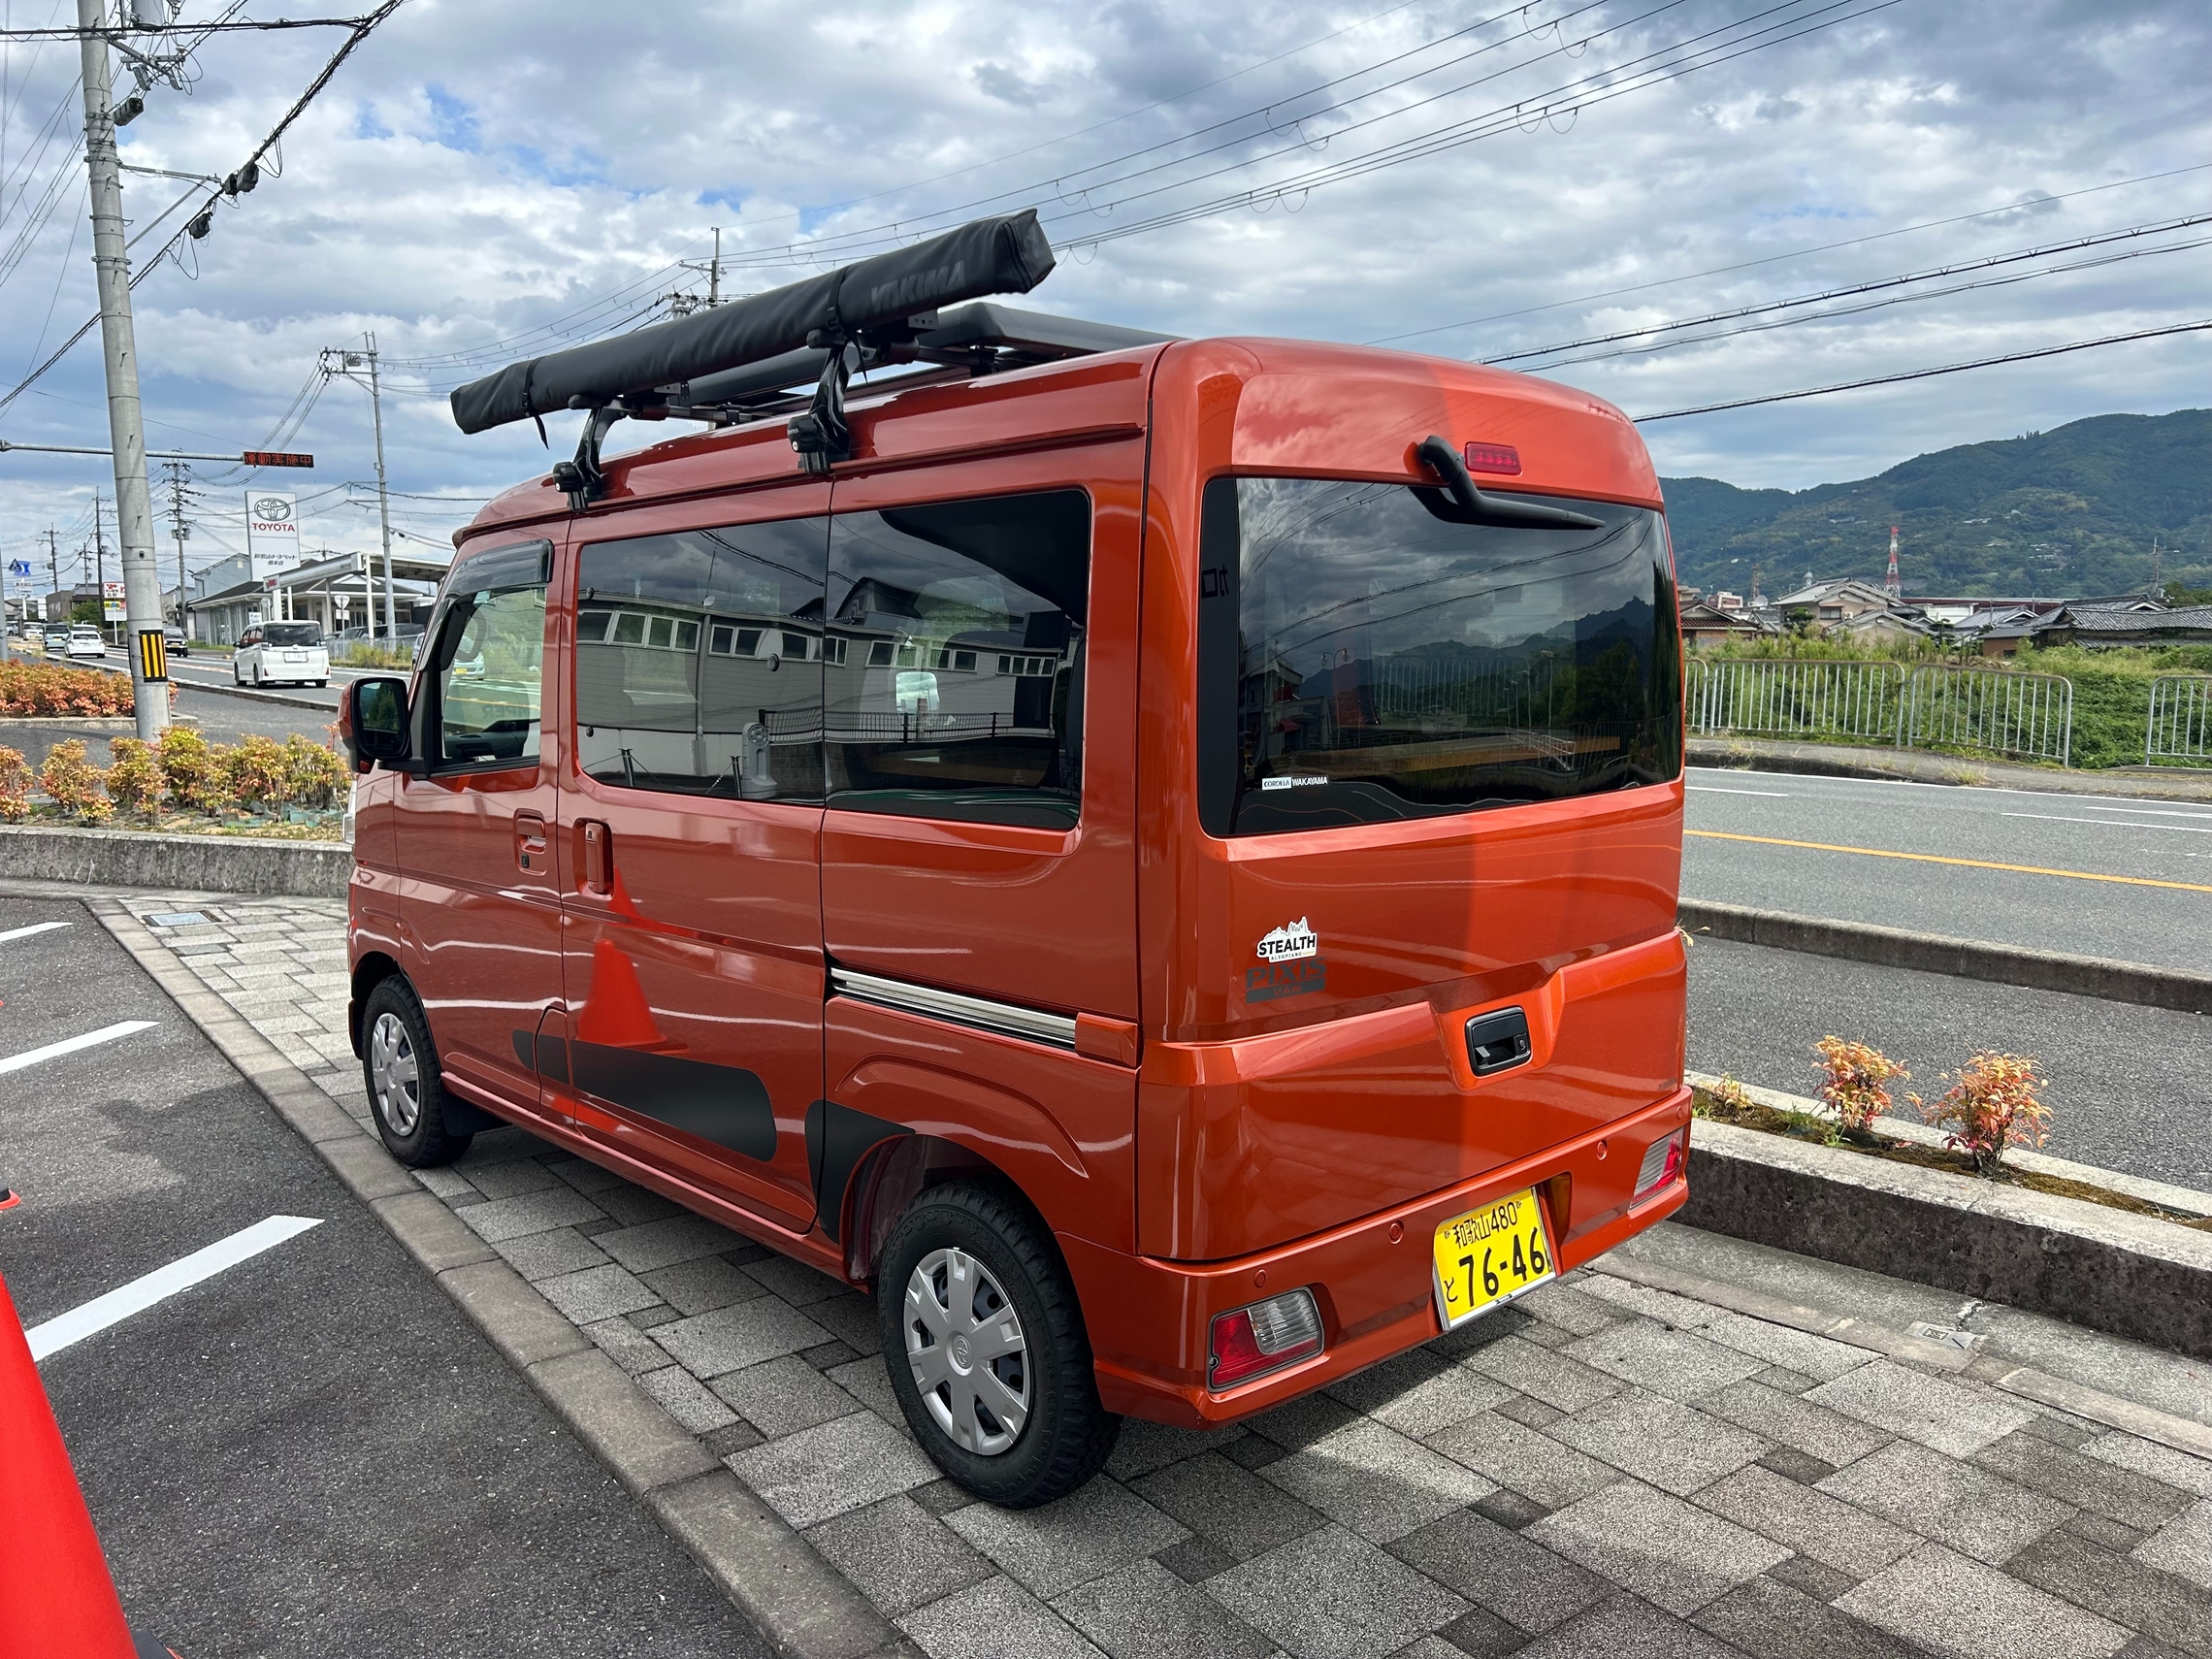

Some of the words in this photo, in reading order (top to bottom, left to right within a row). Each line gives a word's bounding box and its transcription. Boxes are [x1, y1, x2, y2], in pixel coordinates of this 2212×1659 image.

[871, 260, 966, 311] YAKIMA
[245, 451, 311, 467] 運動実施中
[251, 522, 295, 532] TOYOTA
[1291, 776, 1328, 786] WAKAYAMA
[1258, 934, 1316, 956] STEALTH
[1270, 951, 1302, 960] ALTOPIANO
[1246, 957, 1327, 989] PIXIS
[1274, 986, 1302, 996] VAN
[1444, 1277, 1458, 1303] と
[1458, 1226, 1545, 1308] 76-46
